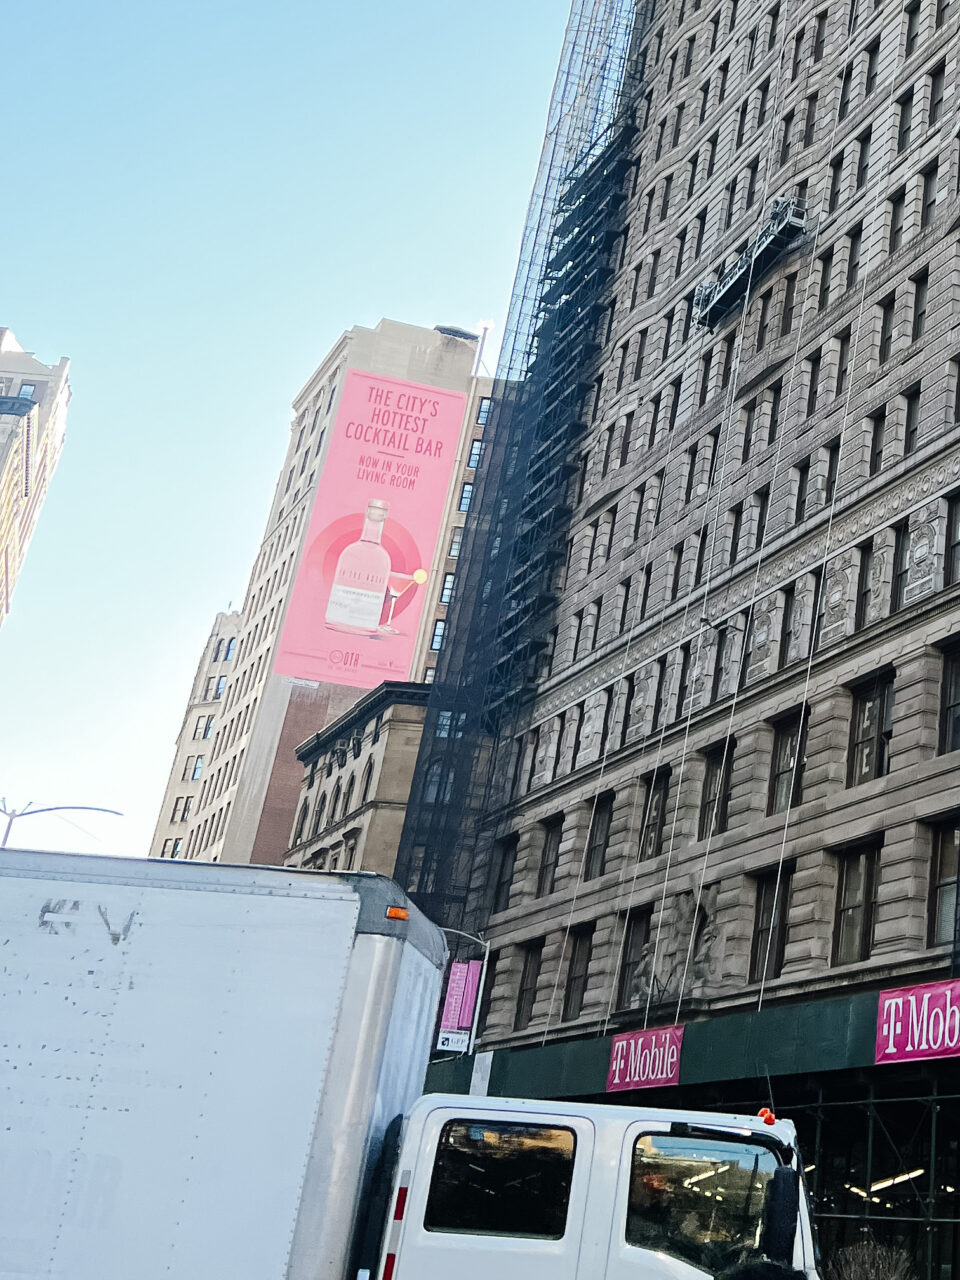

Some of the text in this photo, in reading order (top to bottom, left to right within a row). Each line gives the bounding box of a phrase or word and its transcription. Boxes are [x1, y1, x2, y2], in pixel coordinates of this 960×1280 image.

[368, 387, 440, 417] THE CITY'S
[371, 407, 429, 435] HOTTEST
[345, 422, 443, 458] COCKTAIL BAR
[357, 468, 416, 490] LIVING ROOM
[359, 455, 420, 478] NOW IN YOUR
